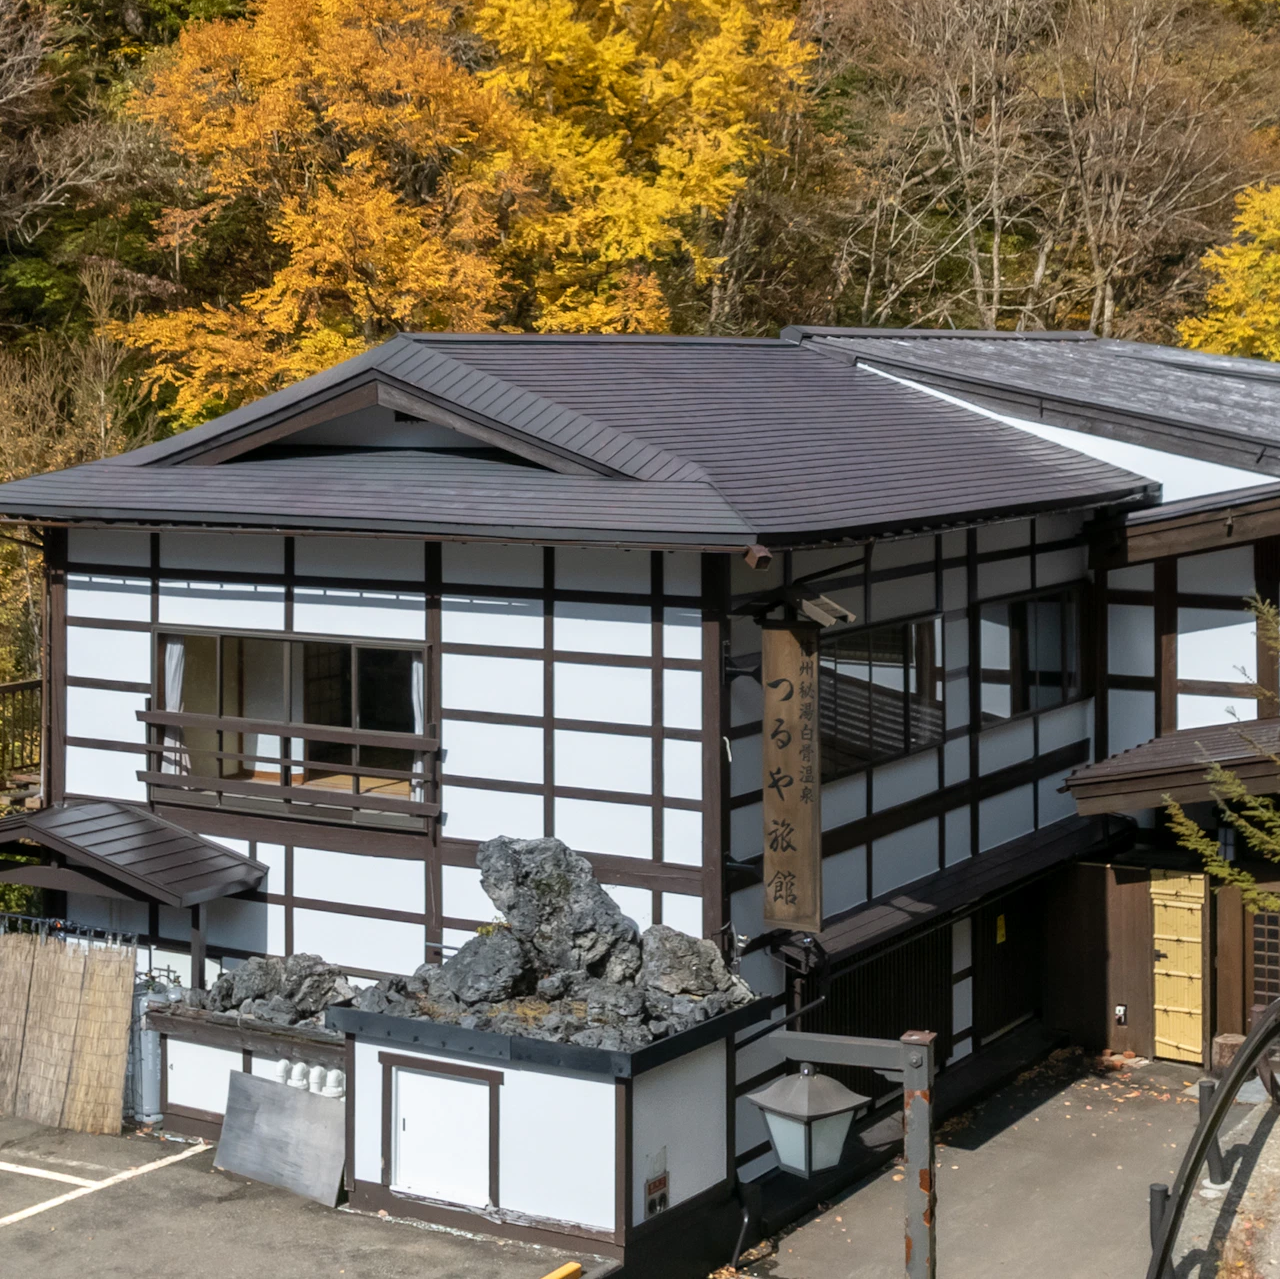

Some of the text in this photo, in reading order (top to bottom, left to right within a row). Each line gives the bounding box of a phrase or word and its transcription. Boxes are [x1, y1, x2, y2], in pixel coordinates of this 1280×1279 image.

[766, 678, 797, 905] つるや旅館
